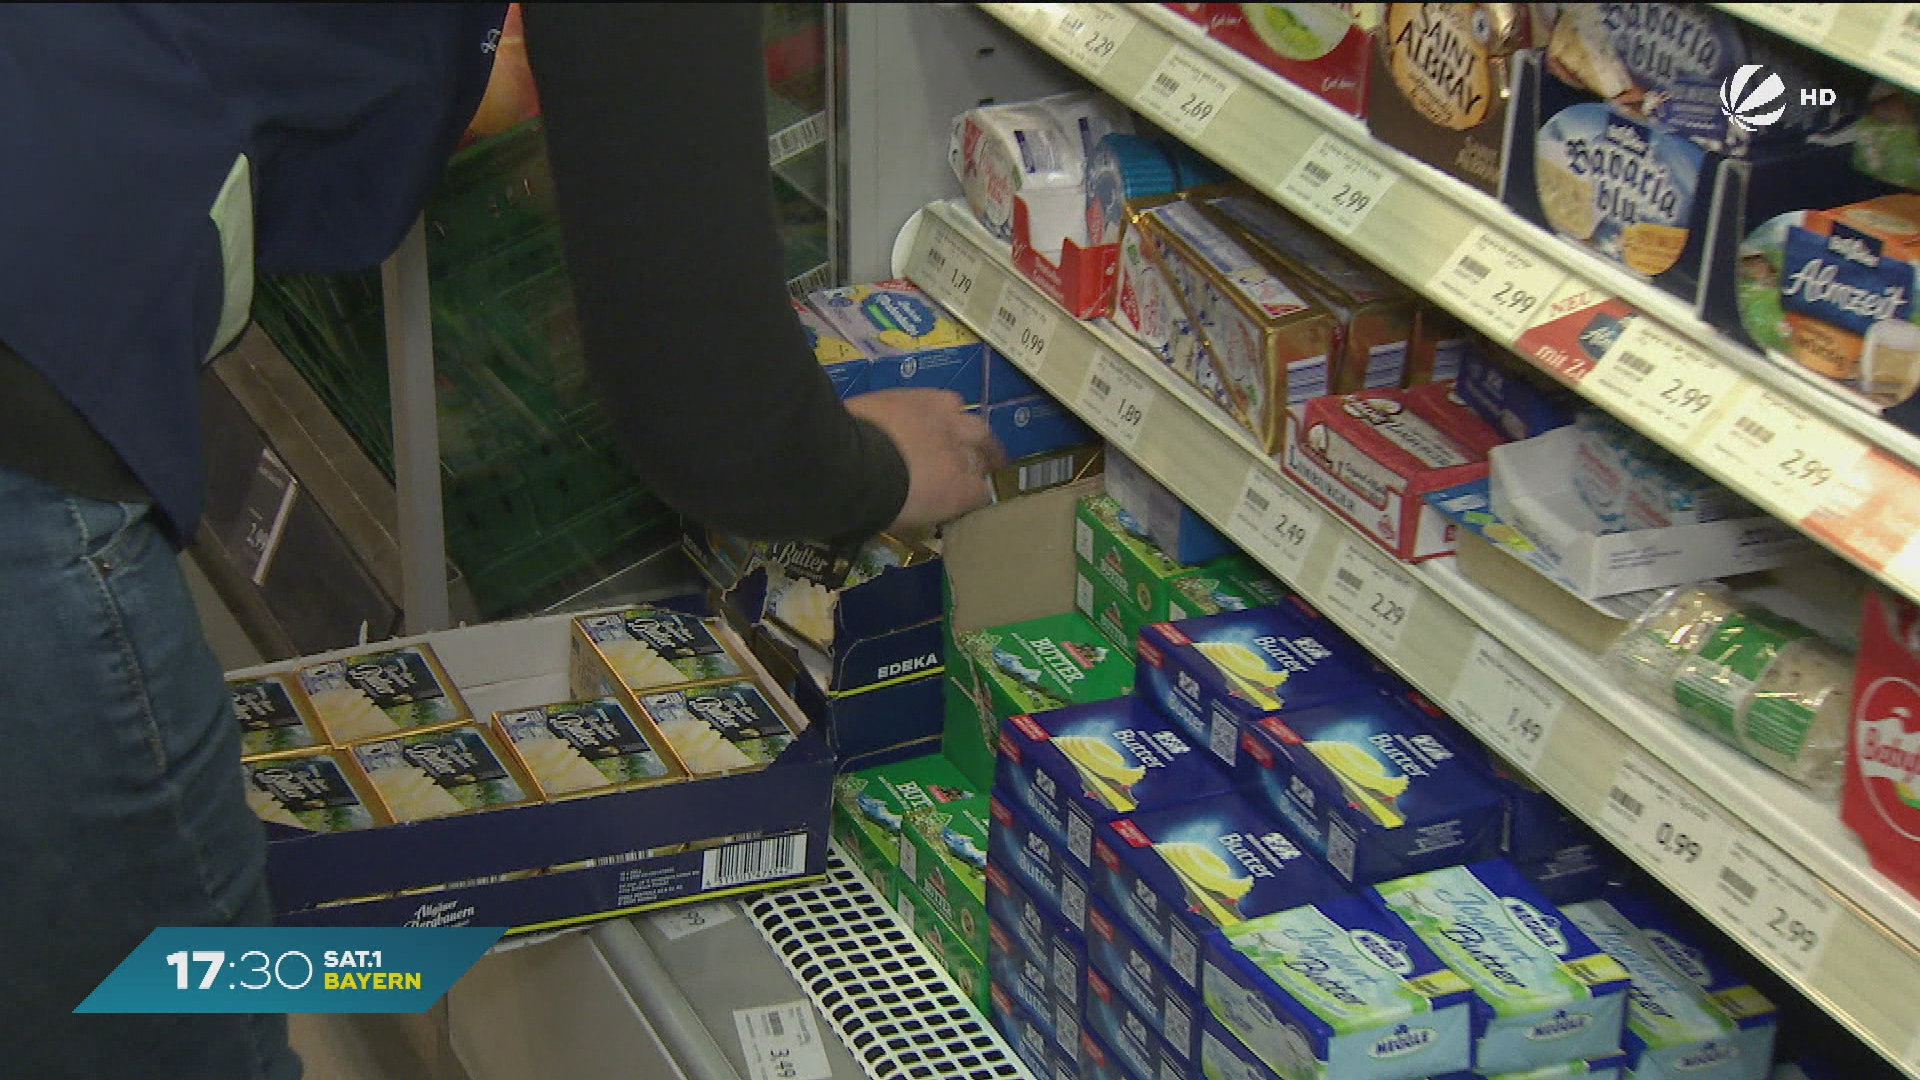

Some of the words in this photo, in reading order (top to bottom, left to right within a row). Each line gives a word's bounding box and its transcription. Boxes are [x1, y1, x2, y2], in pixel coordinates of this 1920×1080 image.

[1085, 31, 1115, 58] 2,29
[1179, 95, 1212, 121] 2,69
[1332, 184, 1371, 212] 2,99
[951, 268, 972, 294] 1,79
[1492, 281, 1537, 314] 2,99
[1021, 330, 1045, 356] 0,99
[1535, 346, 1569, 368] mit
[1118, 398, 1142, 426] 1,89
[1661, 379, 1711, 413] 2,99
[1779, 449, 1832, 487] 2,99
[1275, 514, 1307, 545] 2,49
[1370, 593, 1405, 625] 2,29
[877, 653, 937, 679] EDEKA
[1030, 637, 1085, 683] BUTTER
[1253, 636, 1308, 672] Butter
[1506, 707, 1543, 744] 1,49
[1111, 728, 1165, 768] Butter
[1368, 733, 1430, 777] Butter
[1218, 832, 1275, 878] Butter
[1656, 822, 1702, 864] 0,99
[1766, 906, 1819, 953] 2,99
[1439, 922, 1527, 989] Butter
[1283, 956, 1368, 1006] Butter
